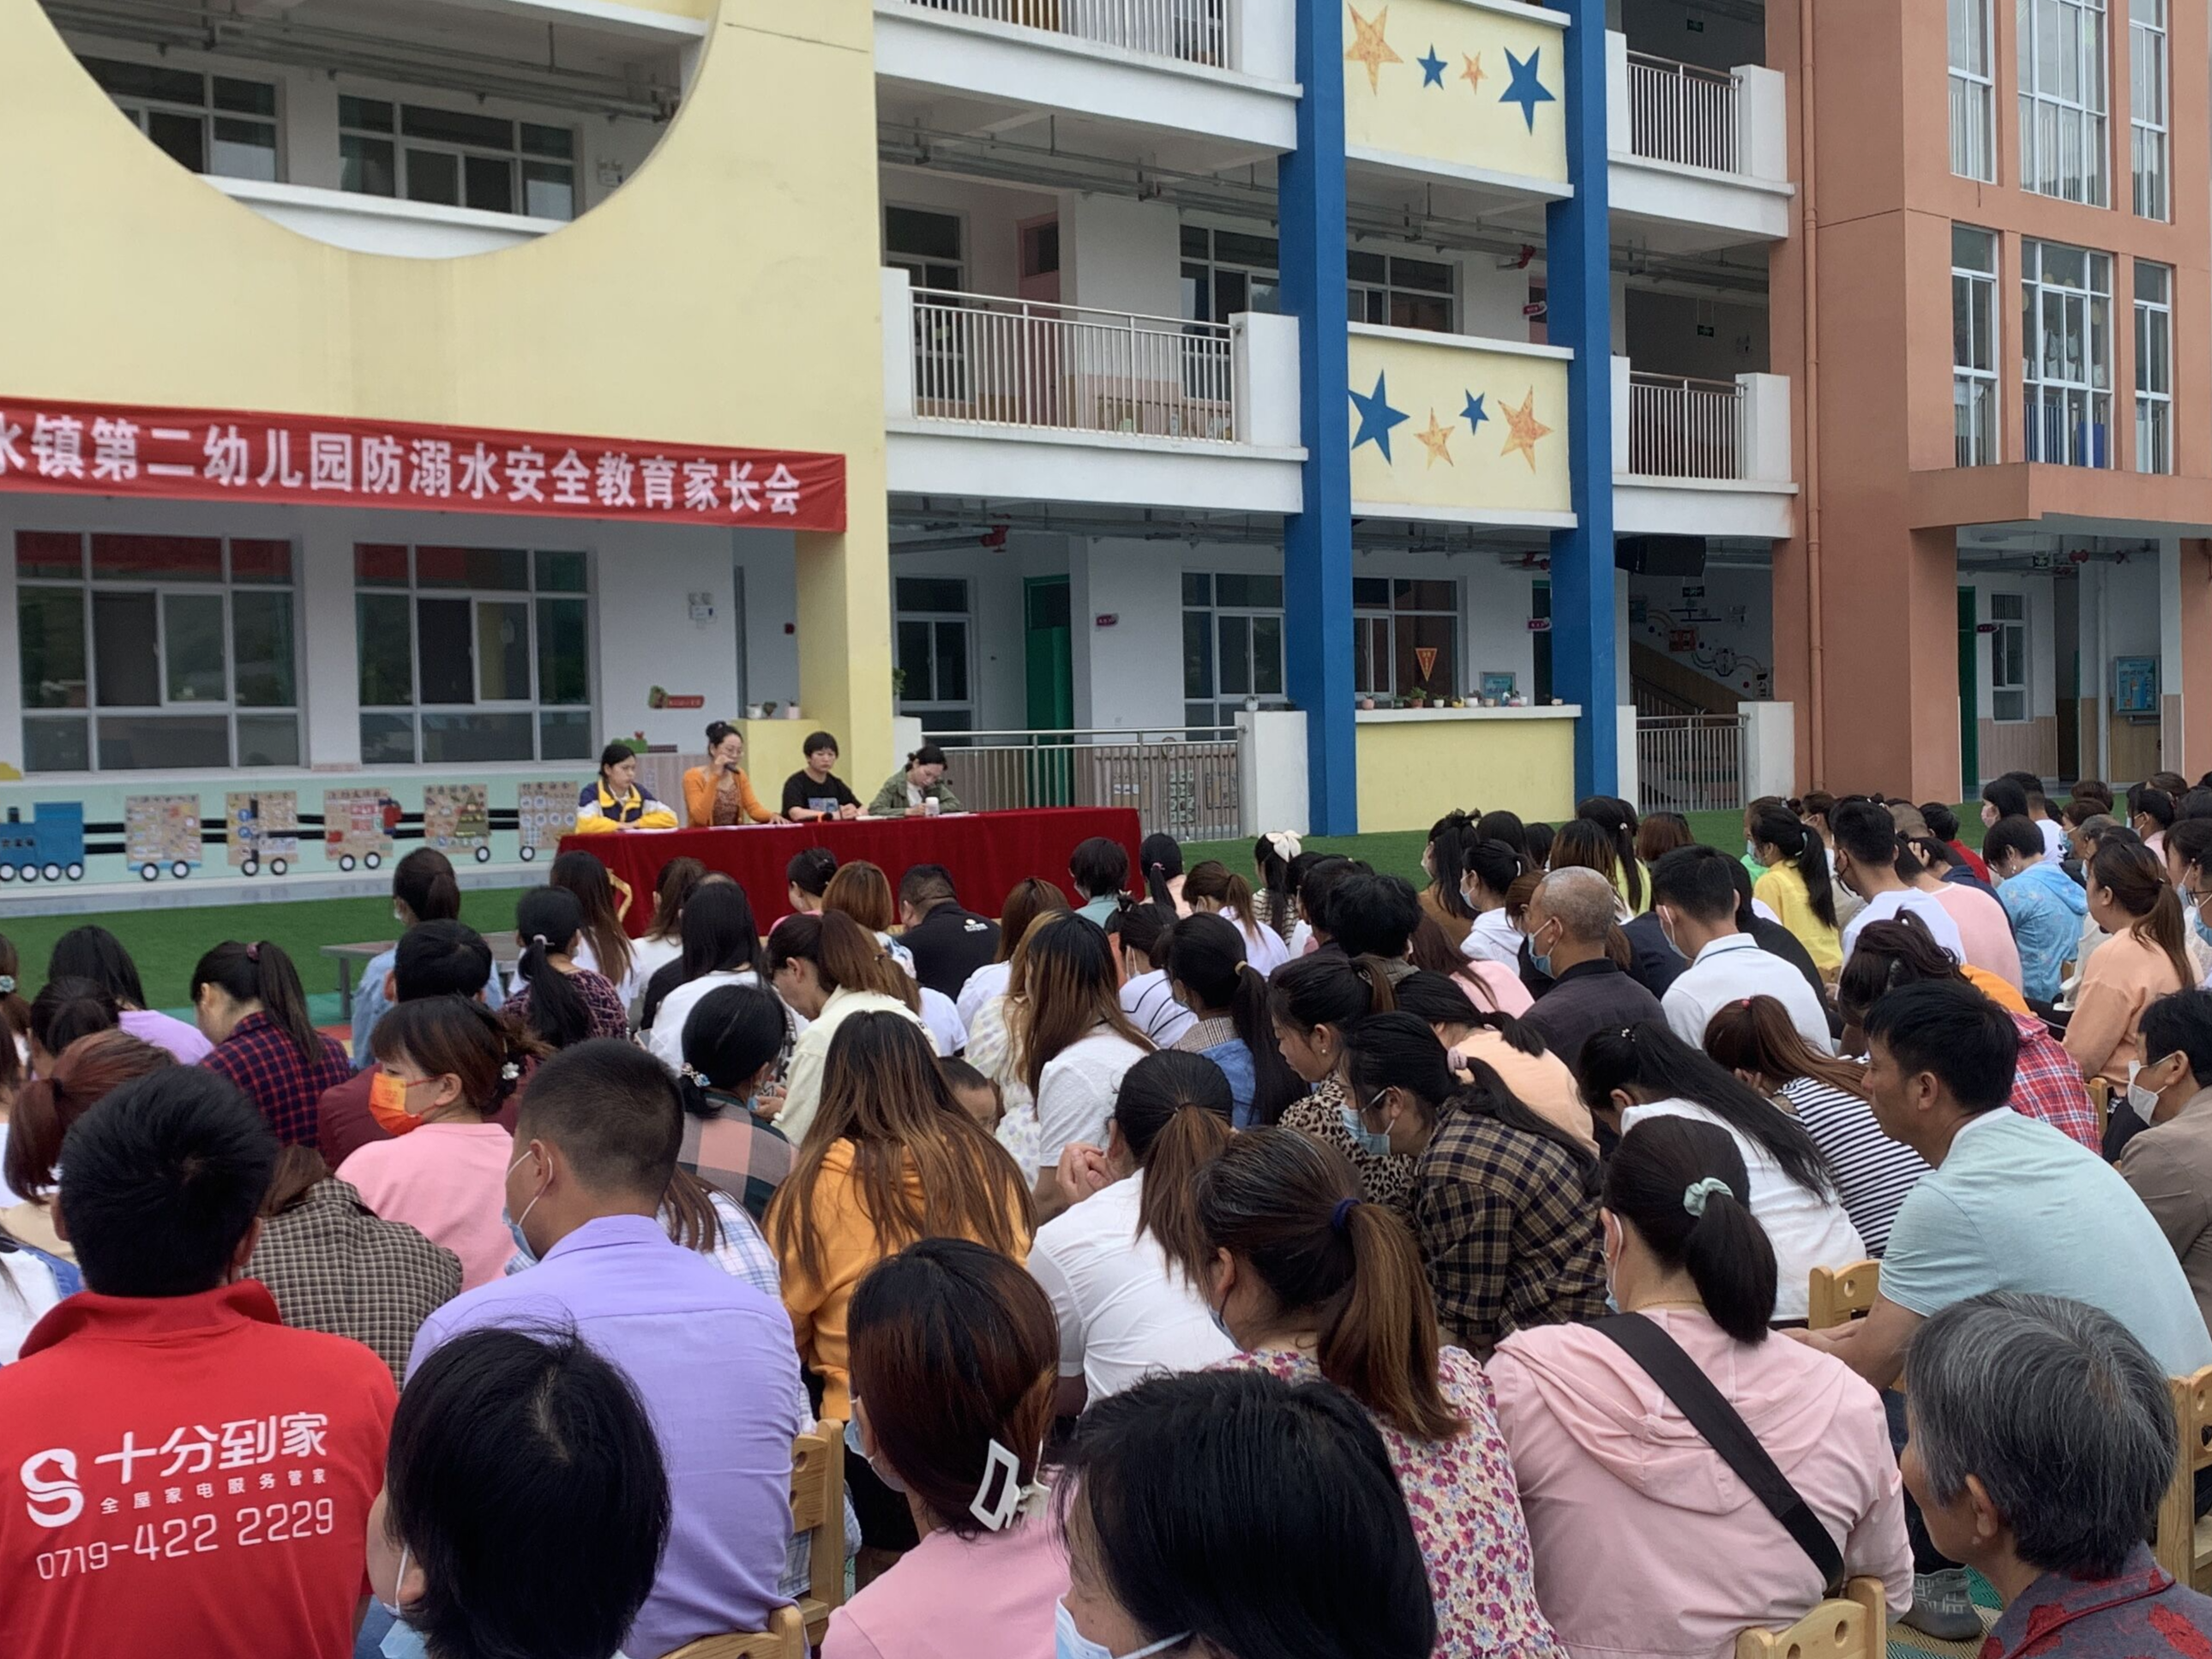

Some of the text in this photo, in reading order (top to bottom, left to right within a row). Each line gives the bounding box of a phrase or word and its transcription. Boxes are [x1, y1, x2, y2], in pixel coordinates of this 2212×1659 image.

[94, 1411, 328, 1485] 十分到家
[100, 1467, 327, 1514] 全屋家电服务管家
[36, 1497, 334, 1580] 0719-422 2229
